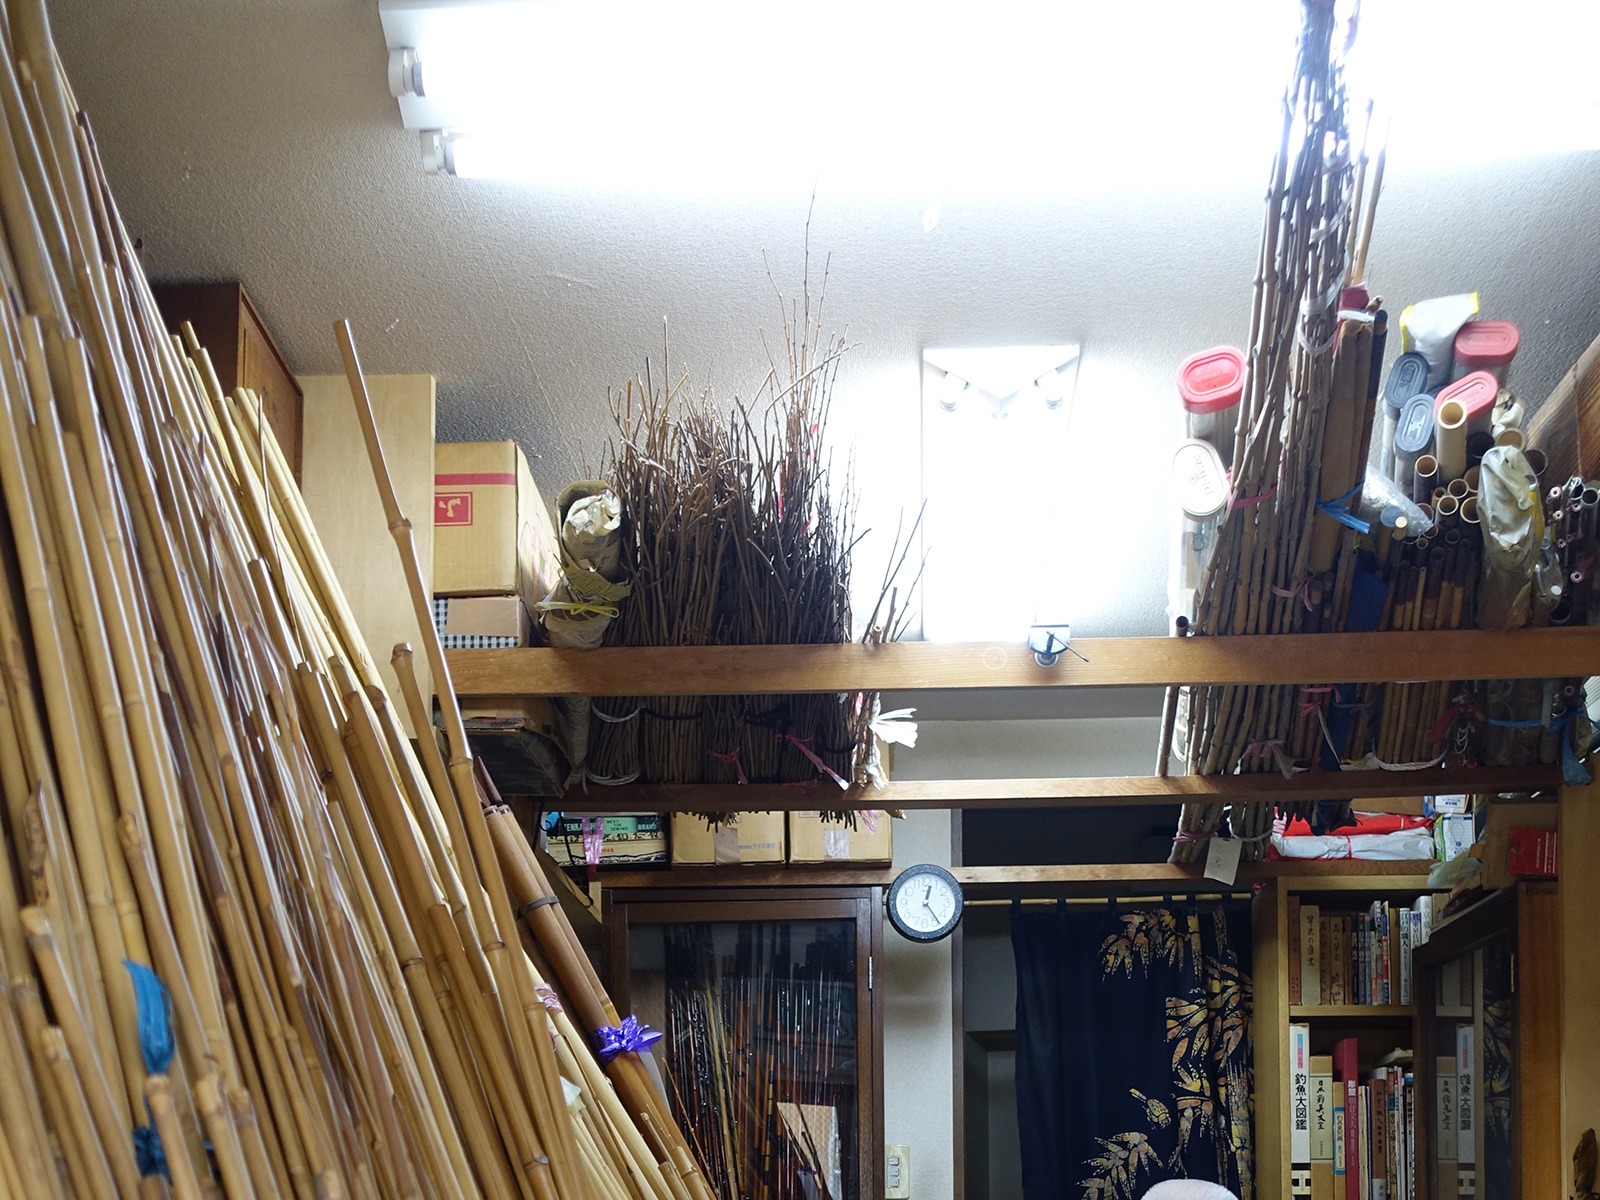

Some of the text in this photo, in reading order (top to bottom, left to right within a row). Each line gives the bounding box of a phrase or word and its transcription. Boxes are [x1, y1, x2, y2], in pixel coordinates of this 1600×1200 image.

[913, 878, 920, 889] 11
[904, 886, 913, 897] 10
[940, 886, 947, 897] 2
[900, 898, 907, 907] 9
[943, 898, 950, 908] 3
[939, 908, 946, 918] 4
[912, 916, 920, 926] 7
[921, 919, 928, 929] 6
[1295, 1073, 1307, 1131] 釣魚大図鑑
